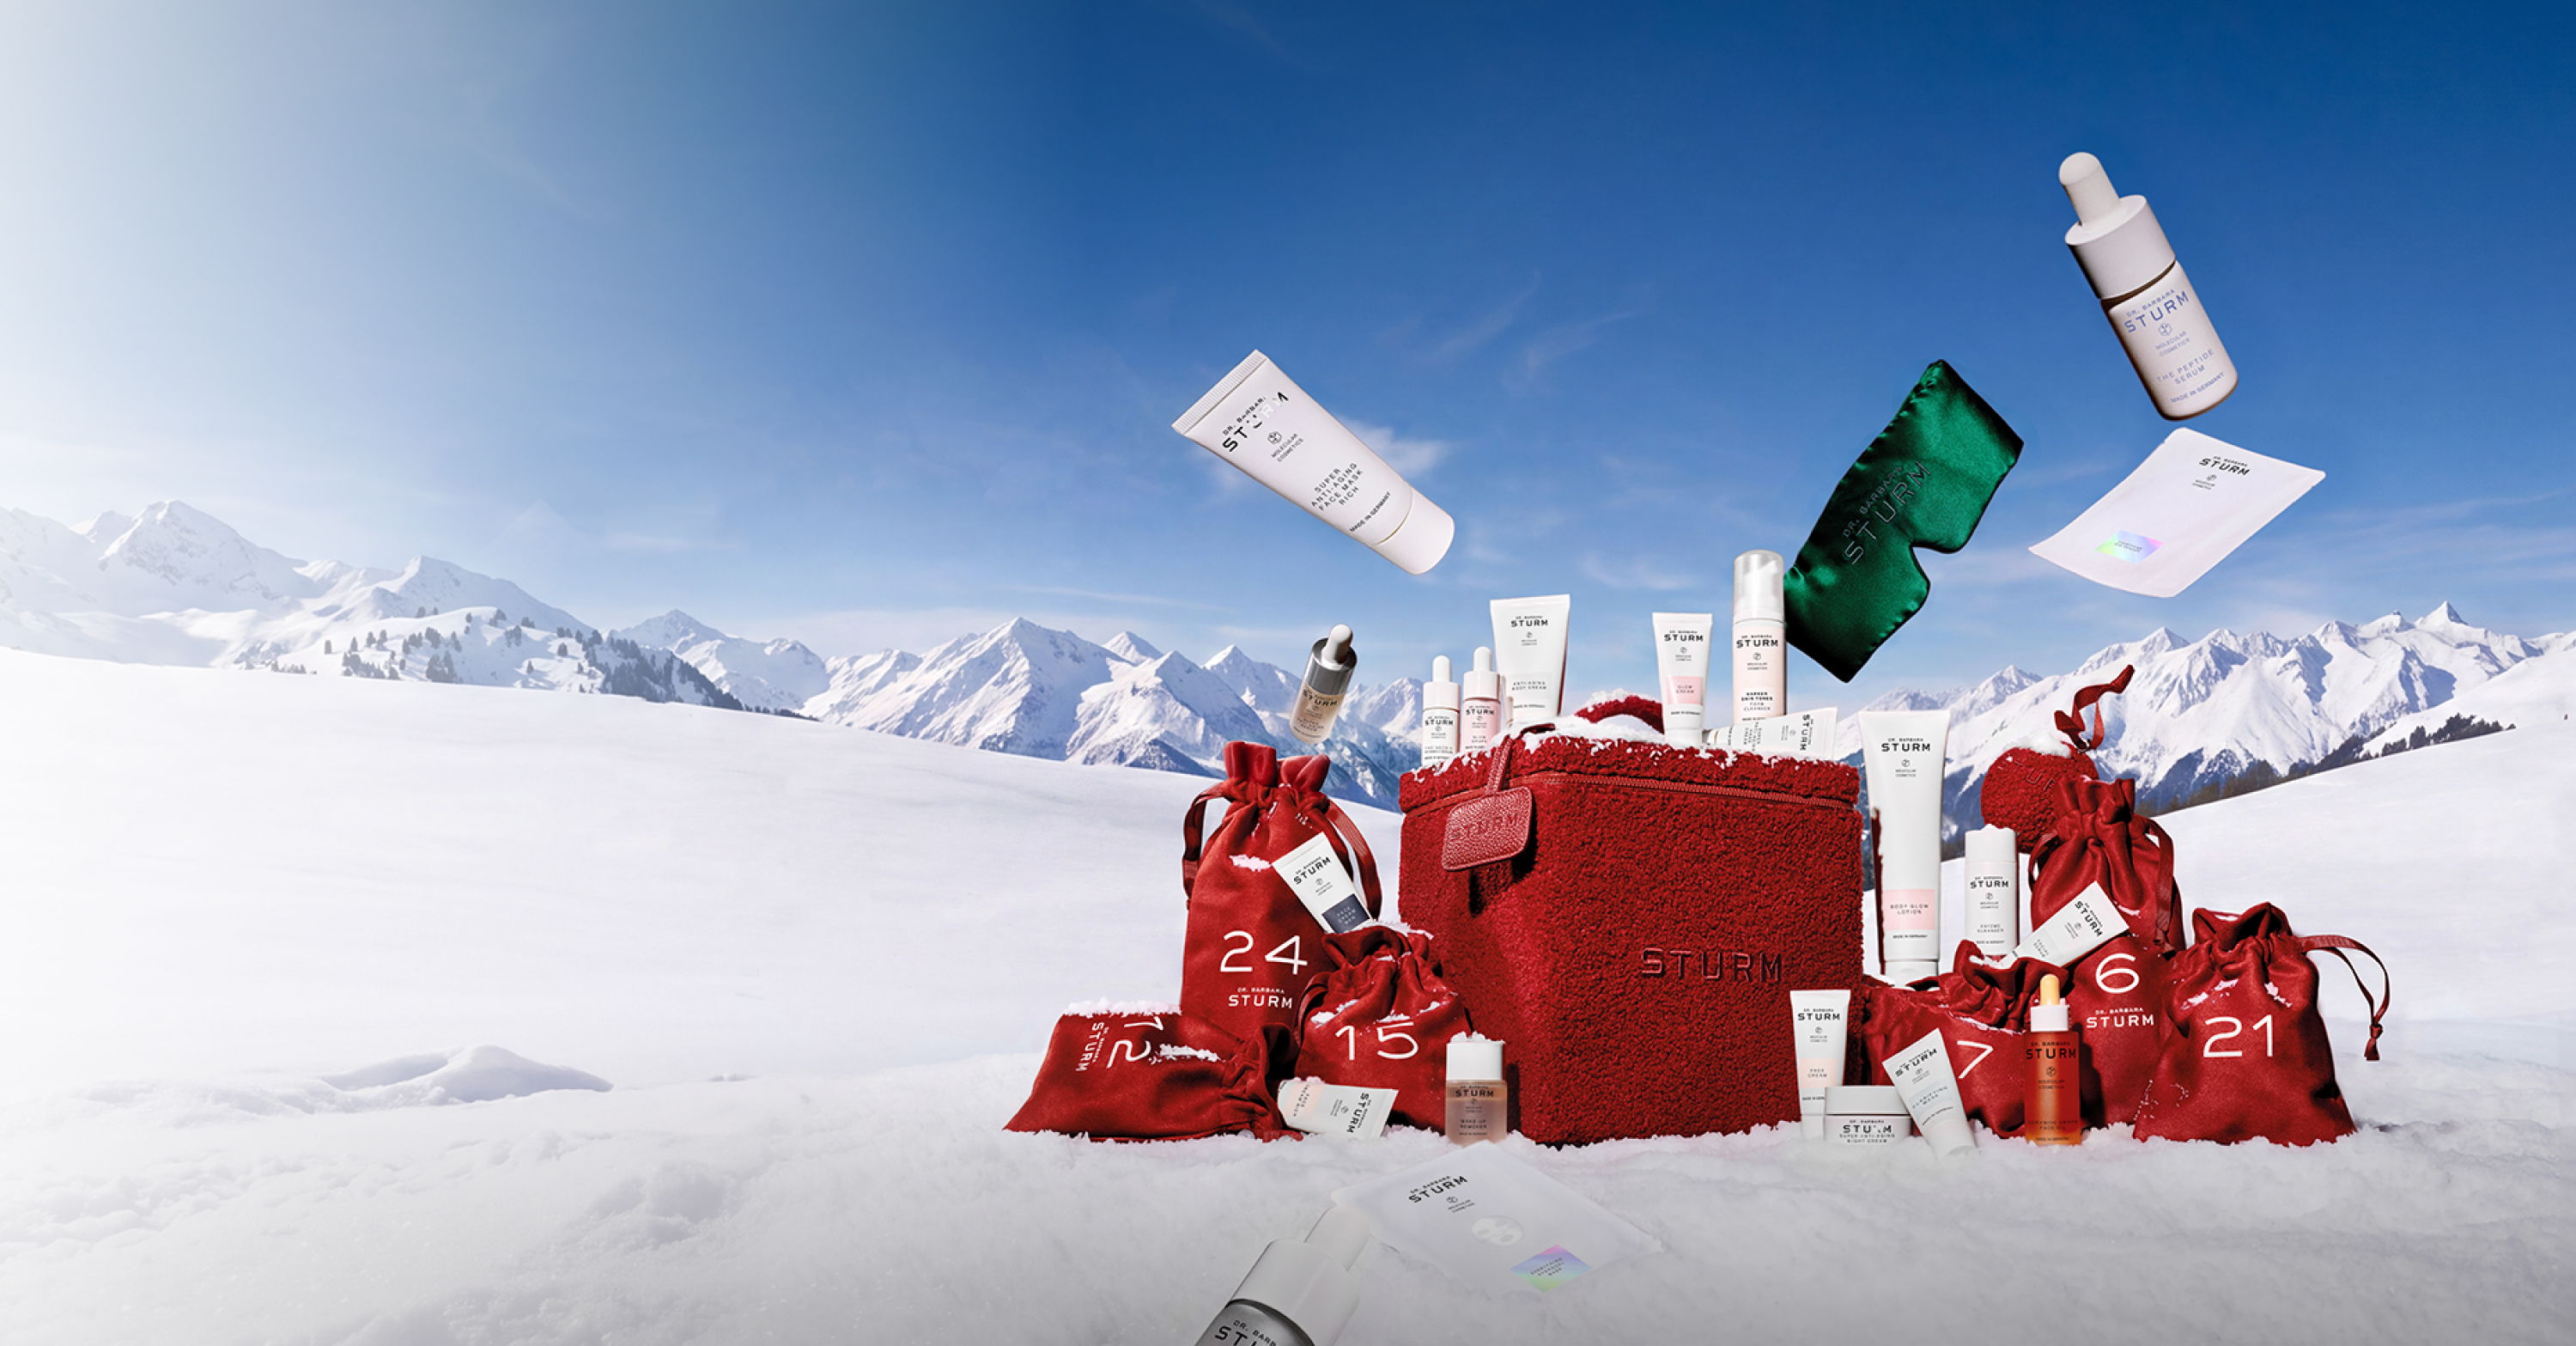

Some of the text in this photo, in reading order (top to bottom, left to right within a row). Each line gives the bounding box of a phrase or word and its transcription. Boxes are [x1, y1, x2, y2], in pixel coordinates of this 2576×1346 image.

[2124, 290, 2189, 332] STURM
[2142, 289, 2174, 310] BARBARA
[2157, 349, 2213, 381] THE PEPTIDE
[2174, 365, 2205, 384] SERUM
[1315, 468, 1340, 493] SUPER
[2199, 458, 2250, 476] STURM
[1311, 463, 1357, 507] ANTI-AGING
[1319, 469, 1363, 511] FACE MASK
[1339, 486, 1358, 505] RICH
[1843, 466, 1902, 538] DR. BARBARA
[1844, 461, 1930, 564] STURM
[1511, 619, 1548, 628] STURM
[1664, 634, 1704, 643] STURM
[1736, 639, 1778, 649] STURM
[1800, 714, 1810, 751] STURM
[1881, 743, 1930, 752] STURM
[1294, 856, 1331, 885] STURM
[1970, 880, 2009, 889] STURM
[2075, 901, 2103, 936] STURM
[1219, 930, 1308, 975] 24
[1641, 947, 1782, 982] STURM
[2096, 953, 2140, 994] 6
[1228, 995, 1292, 1009] STURM
[2086, 1014, 2154, 1028] STURM
[2203, 1014, 2273, 1057] 21
[1075, 1022, 1105, 1071] STURM
[1335, 1021, 1419, 1061] 15
[2026, 1048, 2076, 1059] STURM
[1895, 1048, 1937, 1077] STURM
[1957, 1040, 1994, 1079] 7
[1455, 1089, 1494, 1098] STURM
[1346, 1093, 1369, 1133] STURM
[1408, 1176, 1467, 1203] STURM
[1233, 1320, 1249, 1331] DR.
